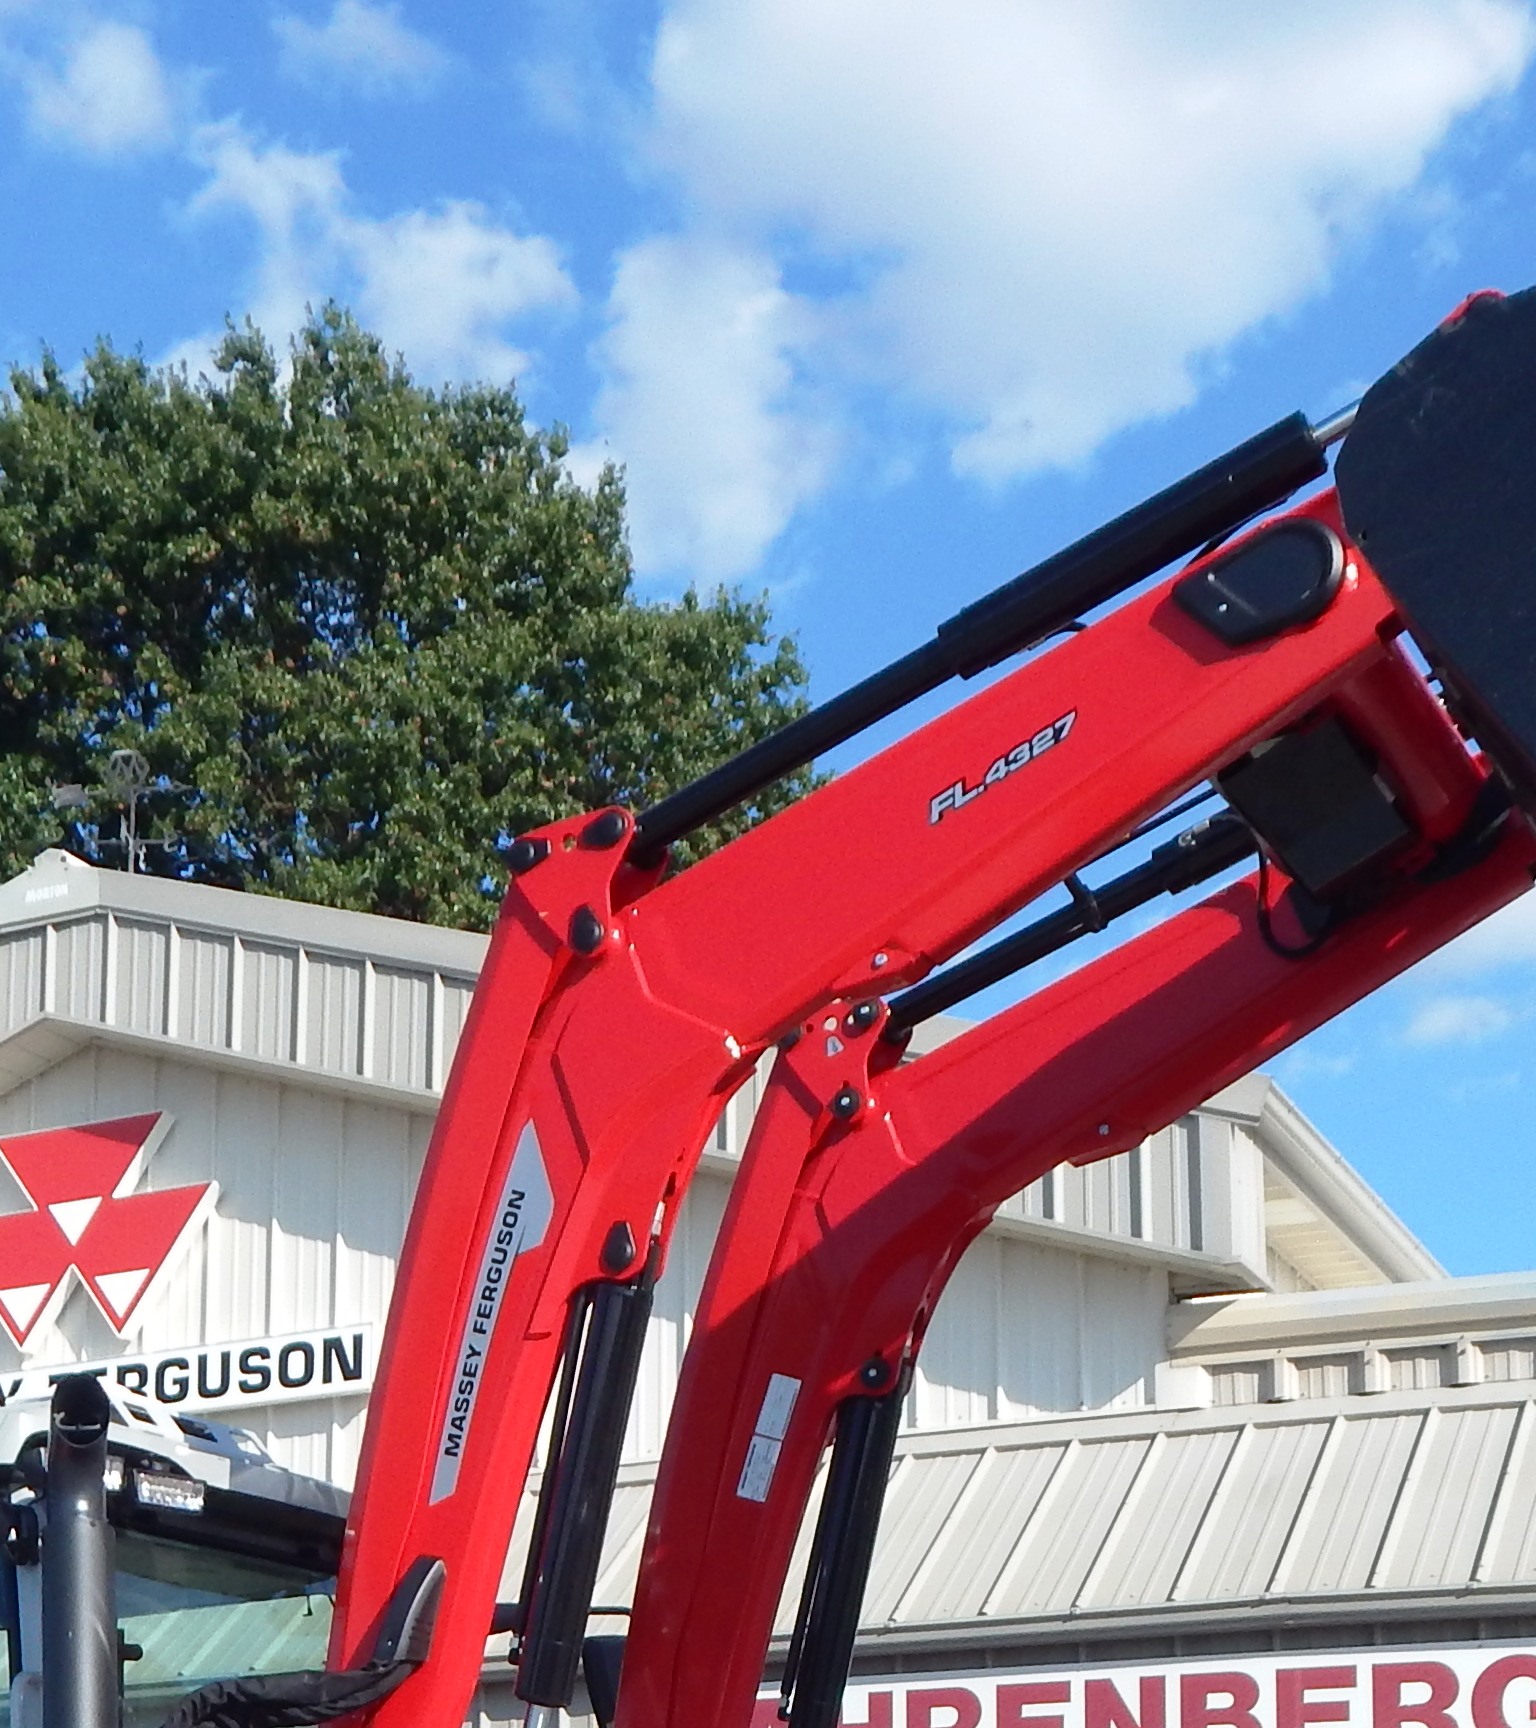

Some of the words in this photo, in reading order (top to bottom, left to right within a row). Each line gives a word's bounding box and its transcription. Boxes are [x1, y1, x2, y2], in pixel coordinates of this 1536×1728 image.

[49, 1331, 364, 1405] RGUSON
[444, 1342, 483, 1457] MASSEY
[473, 1189, 526, 1335] FERGUSON
